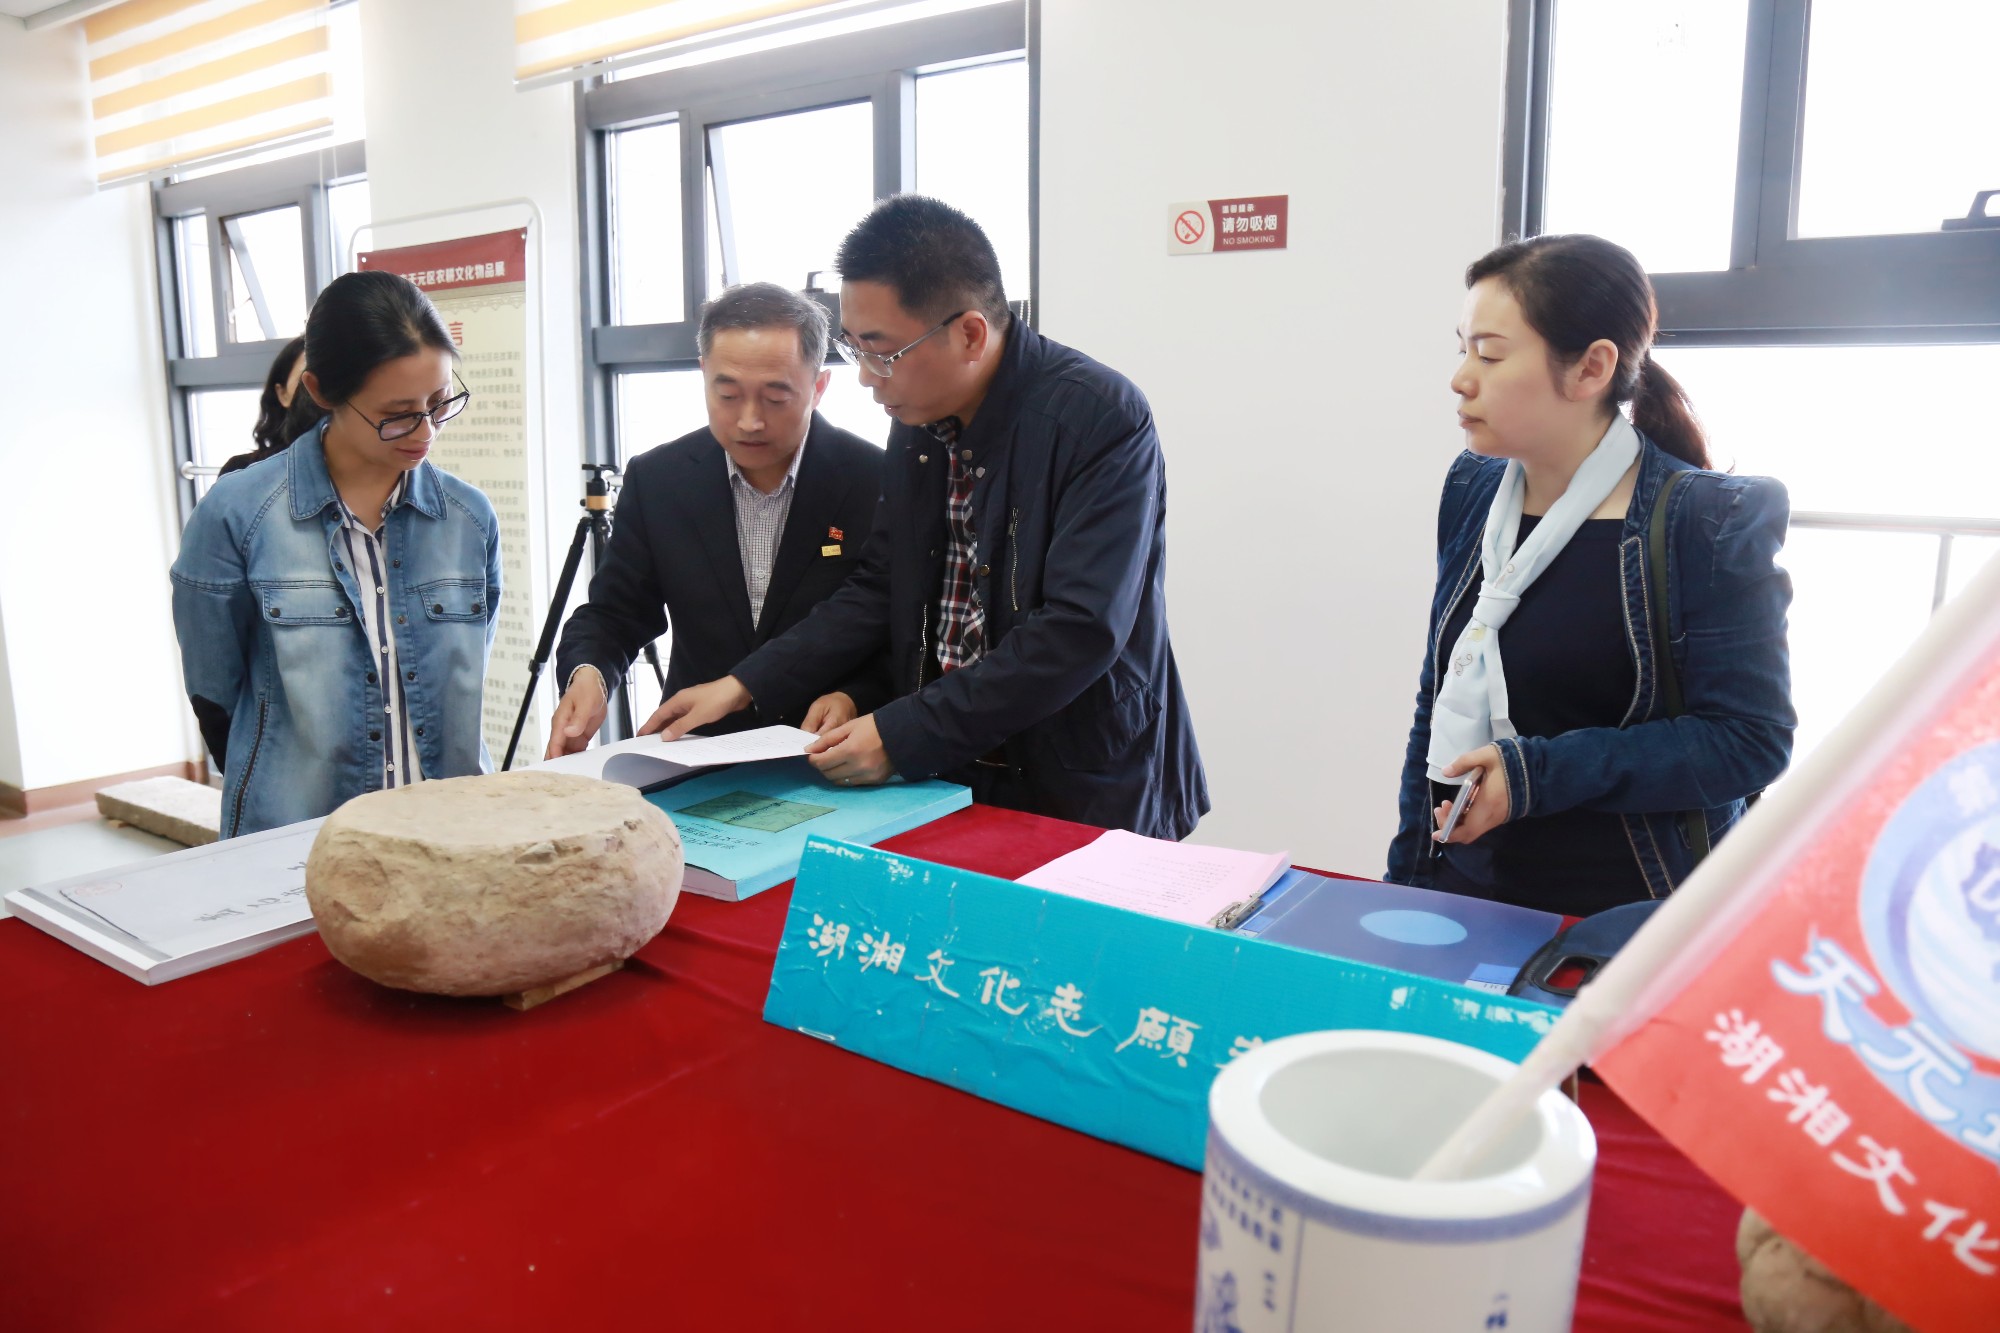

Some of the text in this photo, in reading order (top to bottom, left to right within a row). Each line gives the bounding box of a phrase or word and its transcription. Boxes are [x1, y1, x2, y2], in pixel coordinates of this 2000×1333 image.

[1222, 214, 1278, 234] 请勿吸烟
[1223, 234, 1275, 245] NO SMOKING
[1704, 1009, 2000, 1277] 湖湘文化
